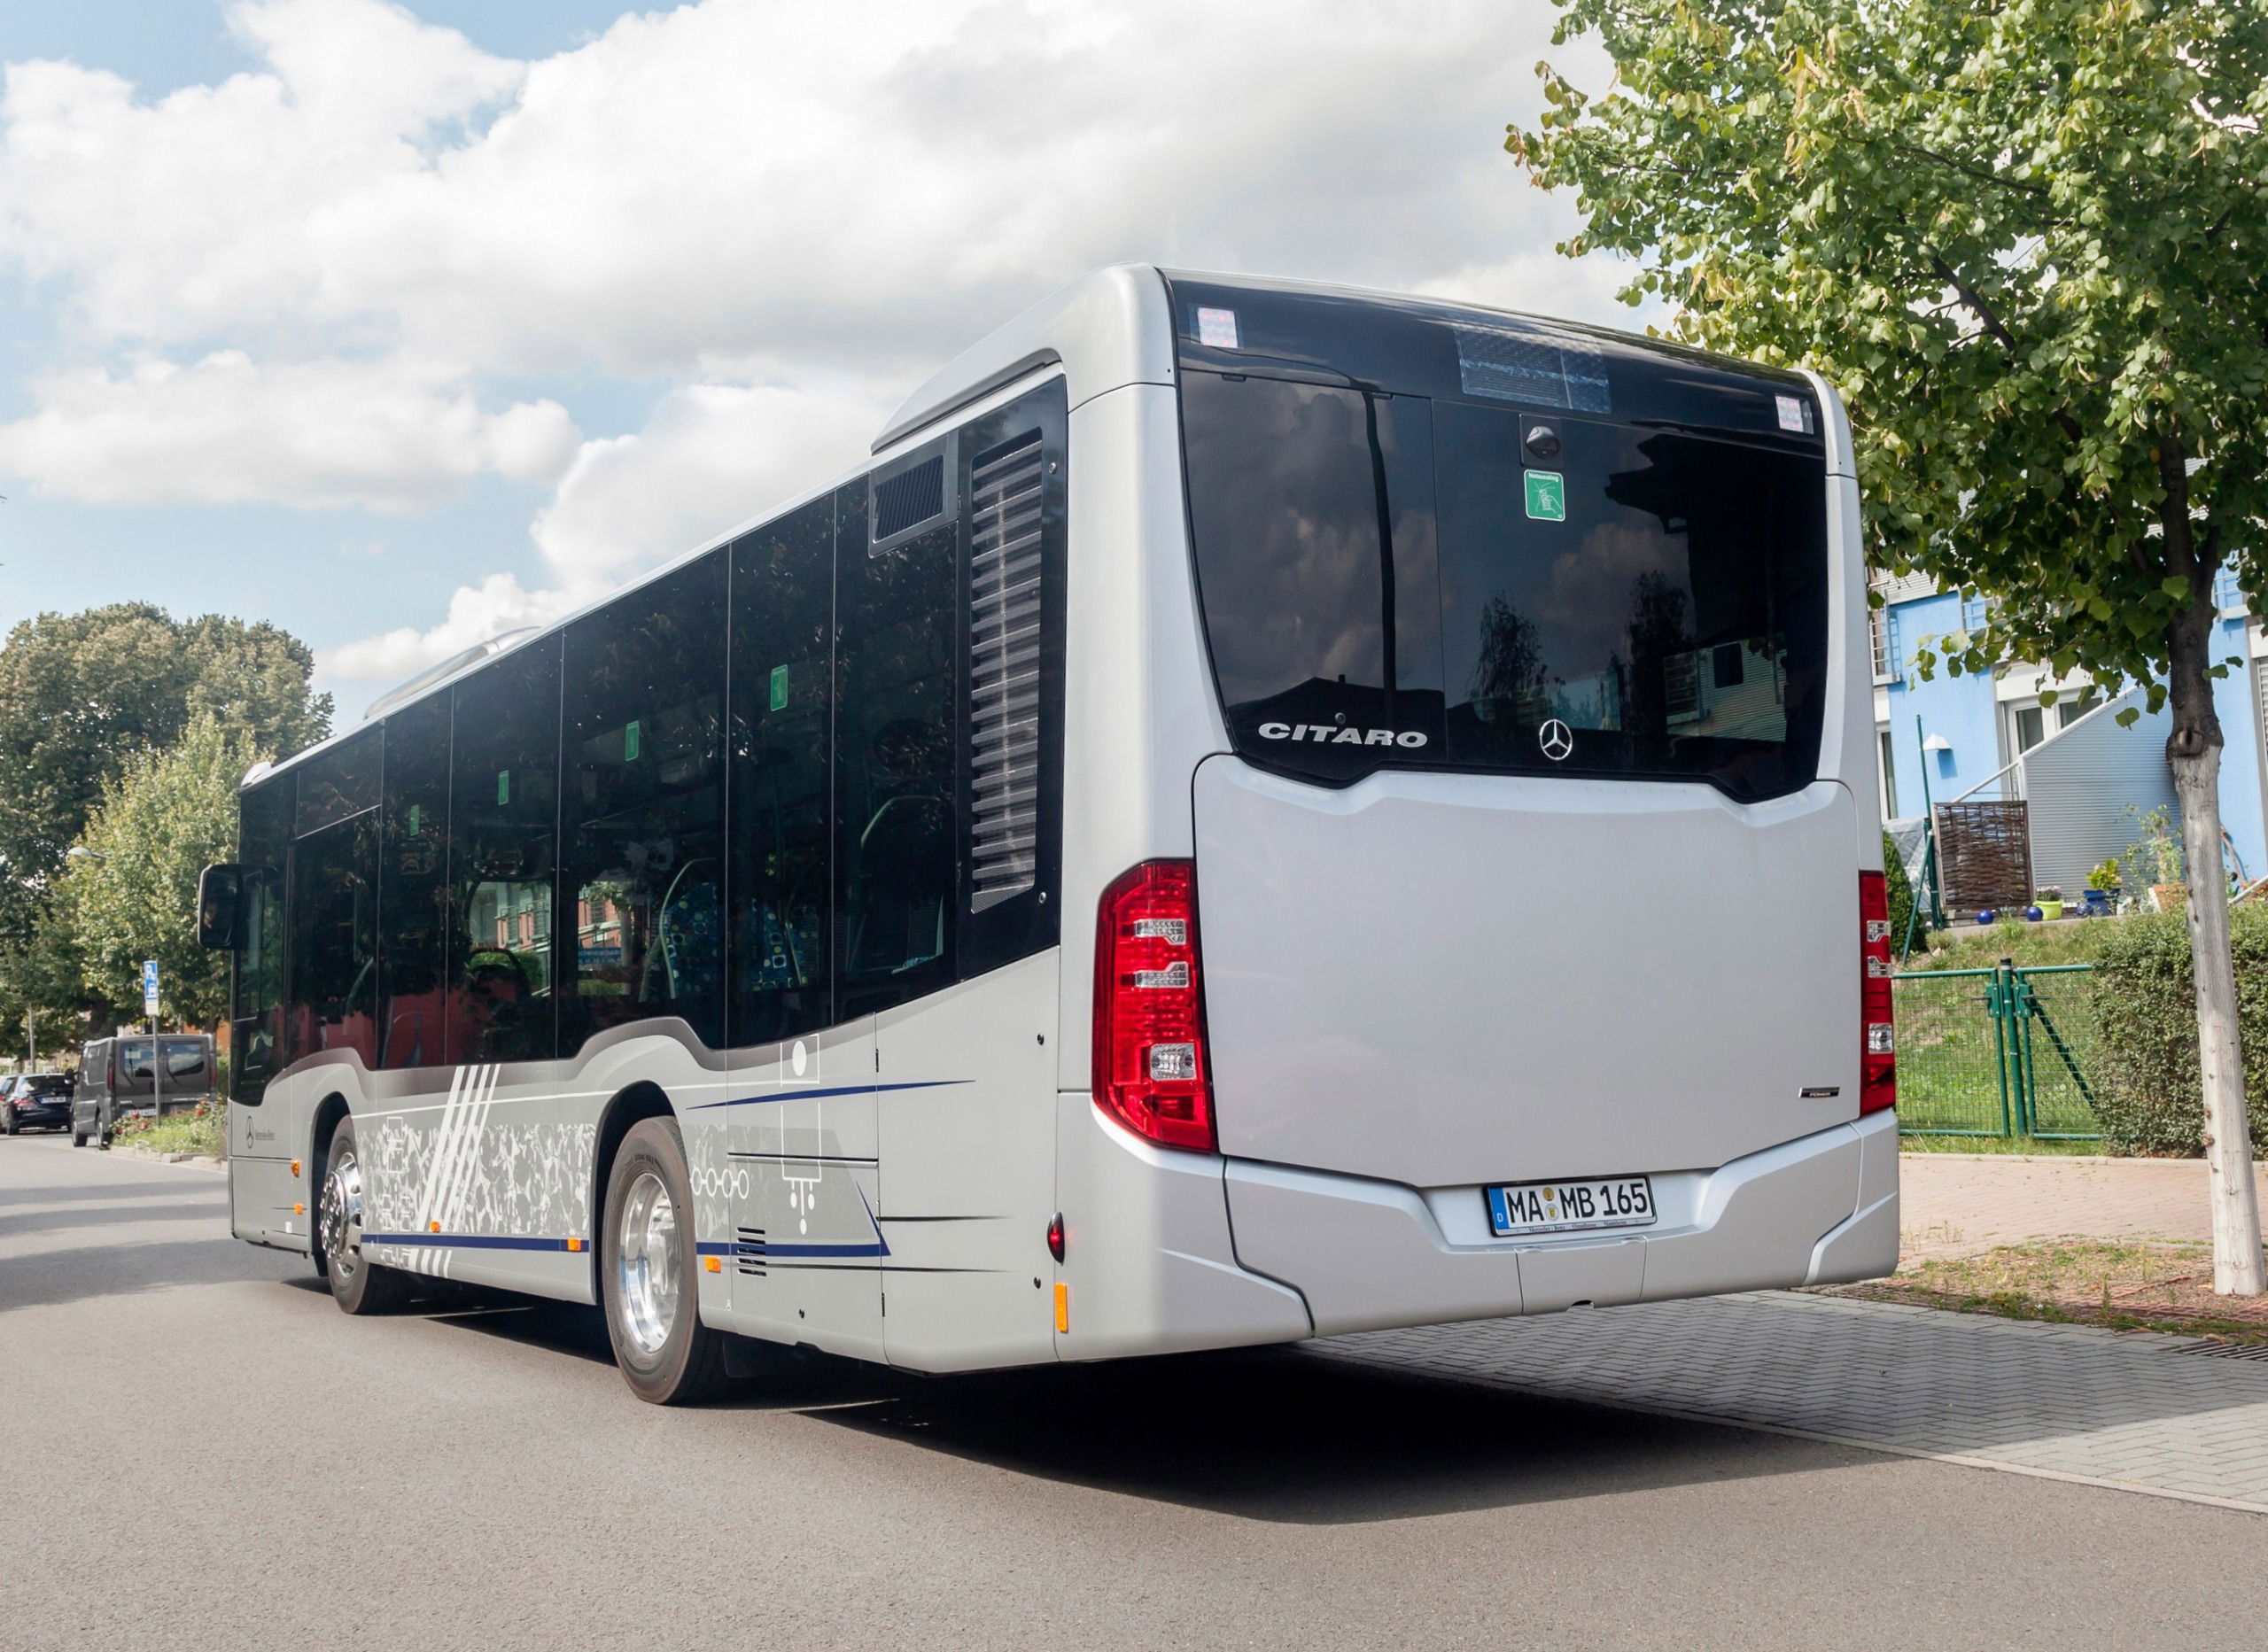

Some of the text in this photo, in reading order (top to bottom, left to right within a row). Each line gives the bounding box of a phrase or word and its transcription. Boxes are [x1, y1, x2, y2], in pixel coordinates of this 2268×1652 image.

[1258, 722, 1428, 748] CITARO
[1506, 1183, 1648, 1223] MA MB 165
[1496, 1212, 1504, 1222] D
